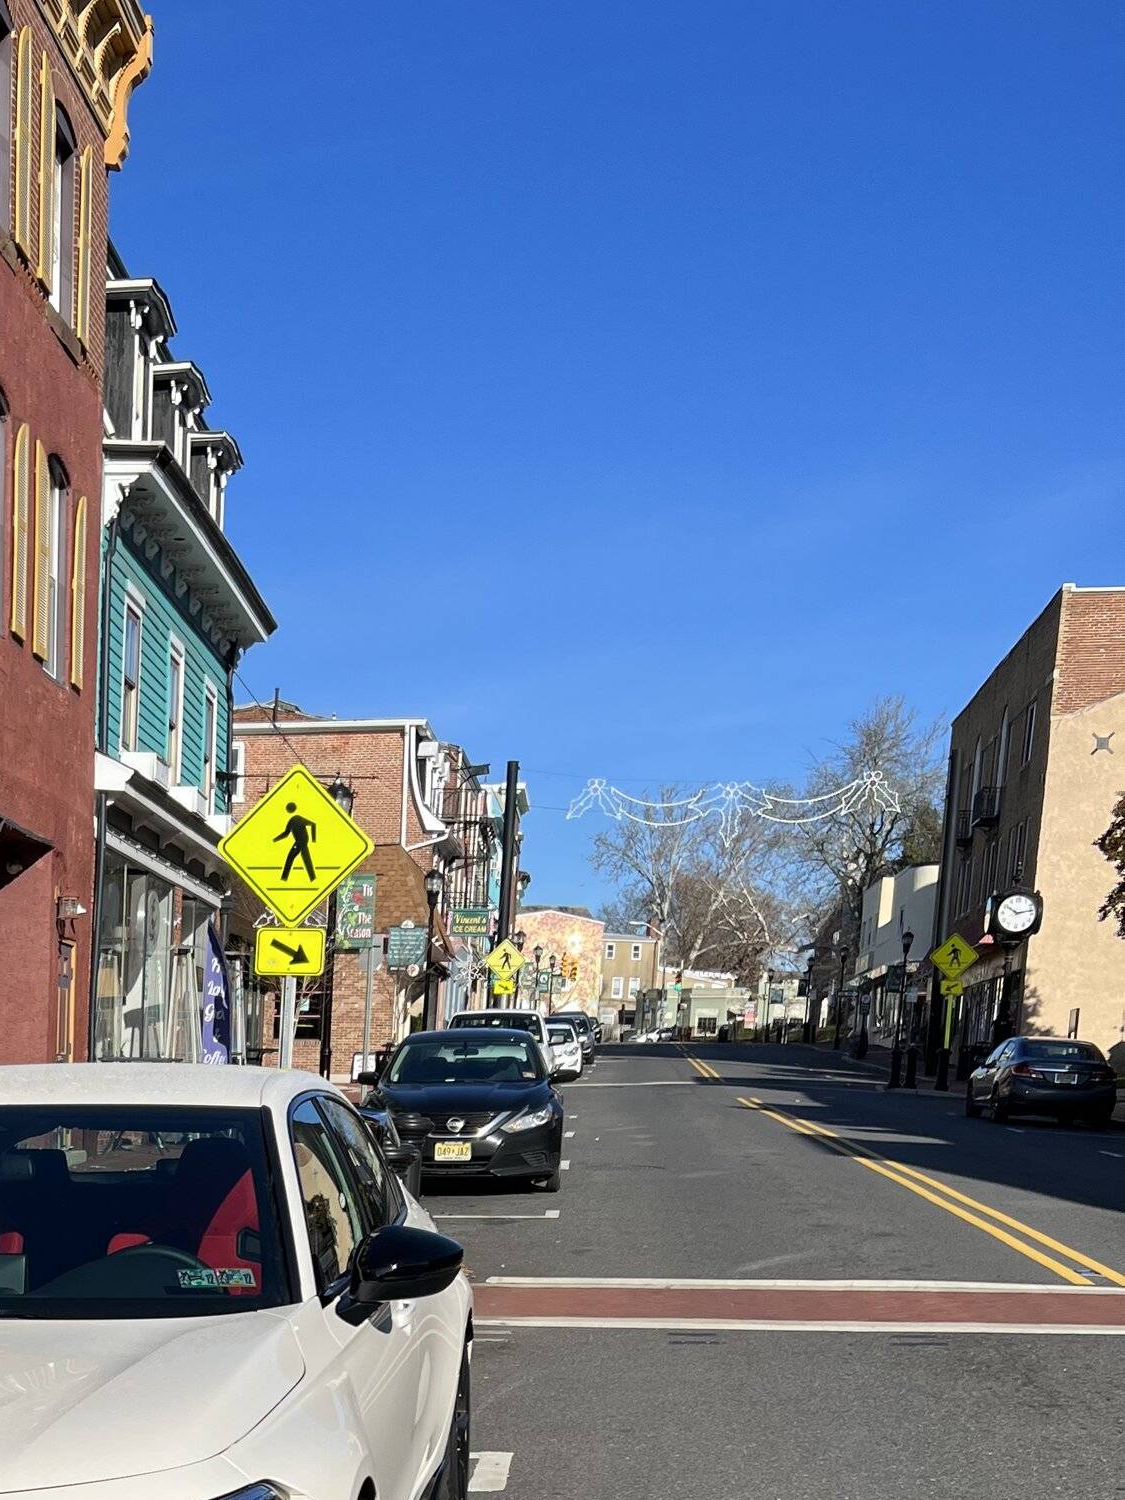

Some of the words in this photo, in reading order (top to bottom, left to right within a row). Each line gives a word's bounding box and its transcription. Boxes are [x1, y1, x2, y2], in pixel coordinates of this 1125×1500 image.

[358, 912, 372, 924] The
[454, 914, 486, 925] Vincent's
[346, 924, 371, 939] Season
